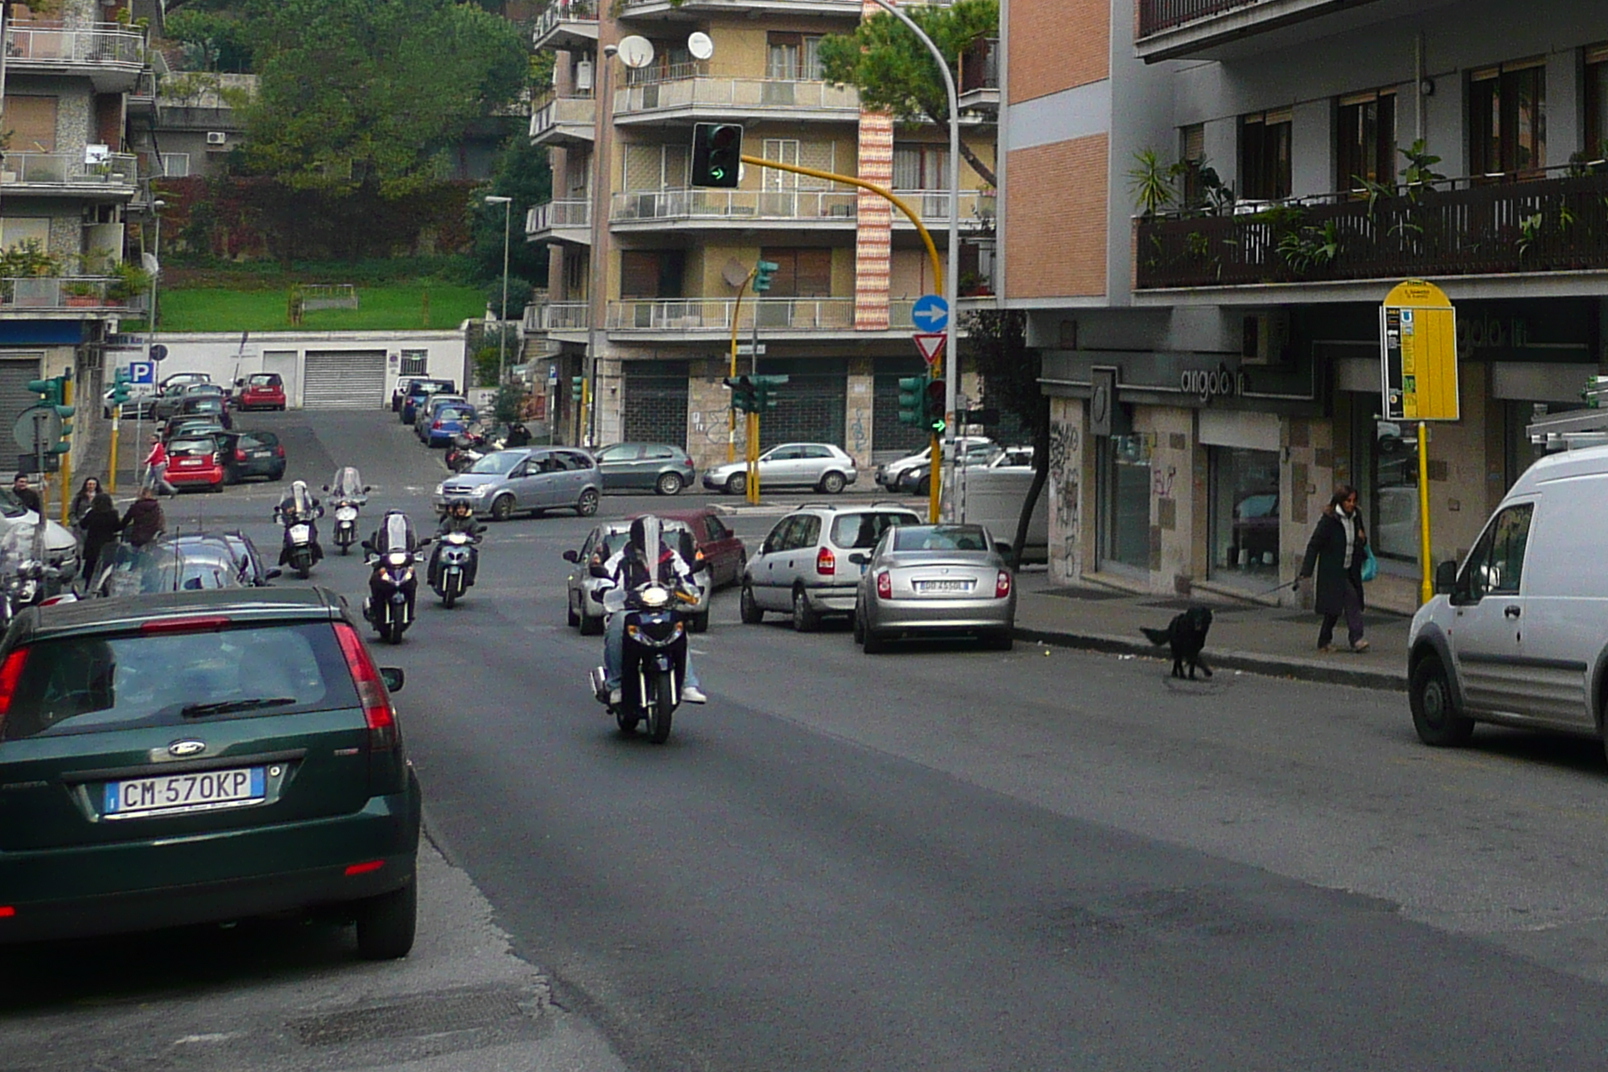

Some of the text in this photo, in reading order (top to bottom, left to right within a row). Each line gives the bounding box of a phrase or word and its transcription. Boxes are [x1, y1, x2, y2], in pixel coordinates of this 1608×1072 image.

[132, 364, 150, 382] P
[1181, 362, 1229, 403] angolo
[166, 771, 248, 803] 570KP
